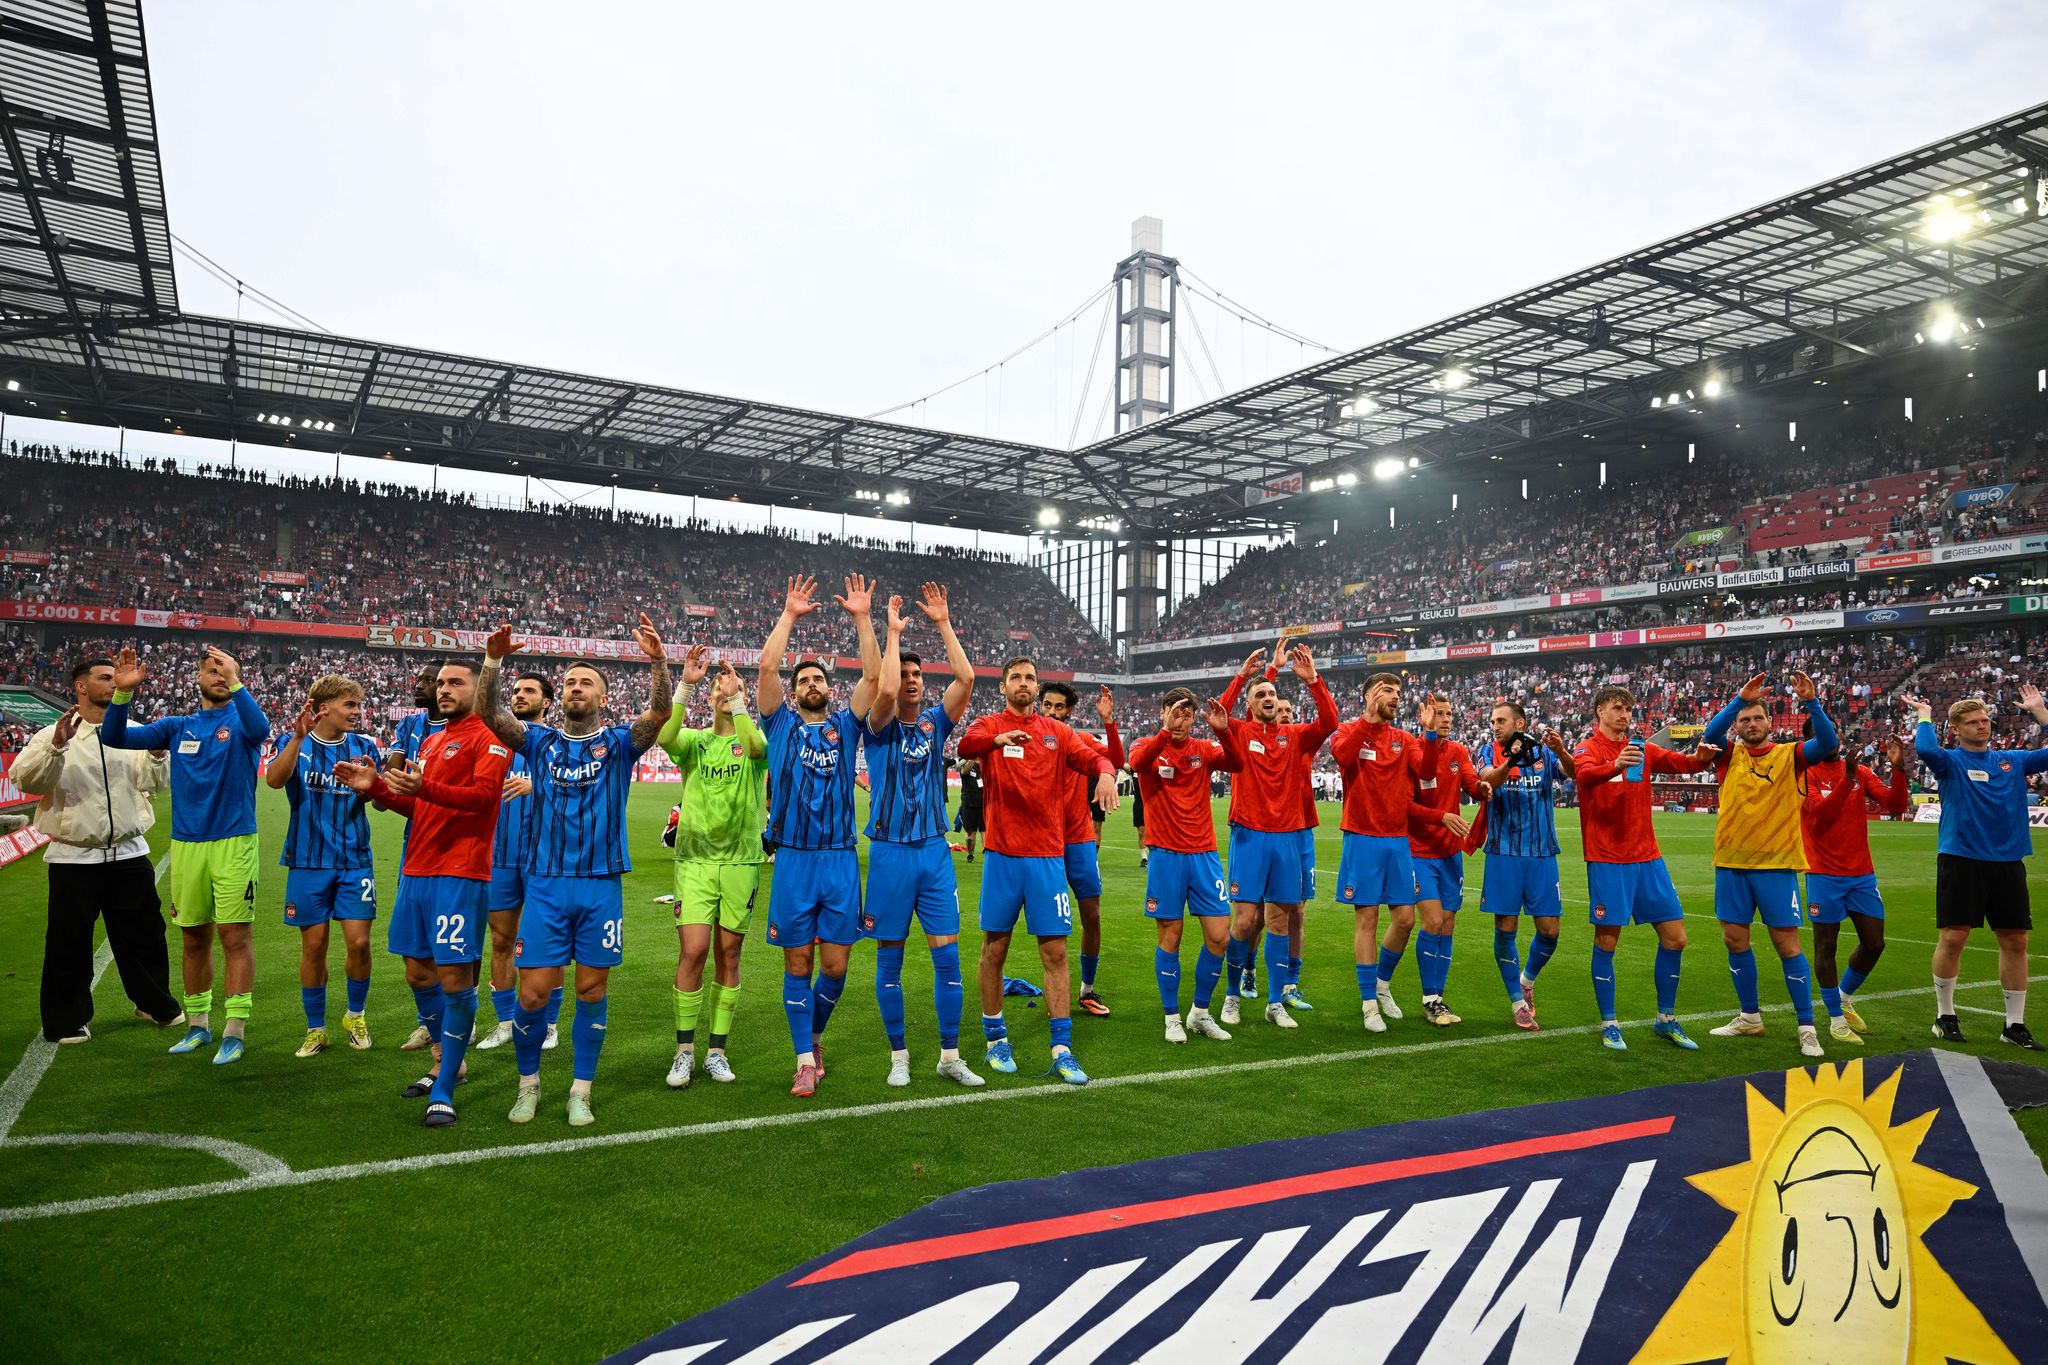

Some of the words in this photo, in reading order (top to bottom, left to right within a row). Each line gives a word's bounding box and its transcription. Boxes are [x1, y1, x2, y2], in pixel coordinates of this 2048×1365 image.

[1952, 543, 2013, 558] GRIESEMANN
[1788, 566, 1815, 578] Gaffel
[1818, 561, 1850, 575] Kölsch
[1660, 577, 1715, 592] BAUWENS
[1722, 573, 1747, 586] Gaffel
[1749, 570, 1778, 582] Kölsch
[15, 605, 79, 619] 15.000
[100, 609, 121, 622] FC
[1419, 609, 1455, 621] KEUK.EU
[1461, 604, 1498, 614] CARGLASS
[1929, 603, 2003, 616] BULLS
[1795, 617, 1836, 627] RheinEnergie
[1871, 612, 1892, 622] Ford
[1286, 627, 1305, 635] DHL
[1308, 622, 1341, 633] REMONDIS
[1727, 624, 1764, 633] RheinEnergie
[1450, 646, 1488, 656] HAGEDORN
[1504, 643, 1535, 652] NetCologne
[564, 761, 602, 780] MHP
[711, 763, 741, 779] MHP
[1054, 892, 1071, 918] 18
[436, 914, 466, 944] 22
